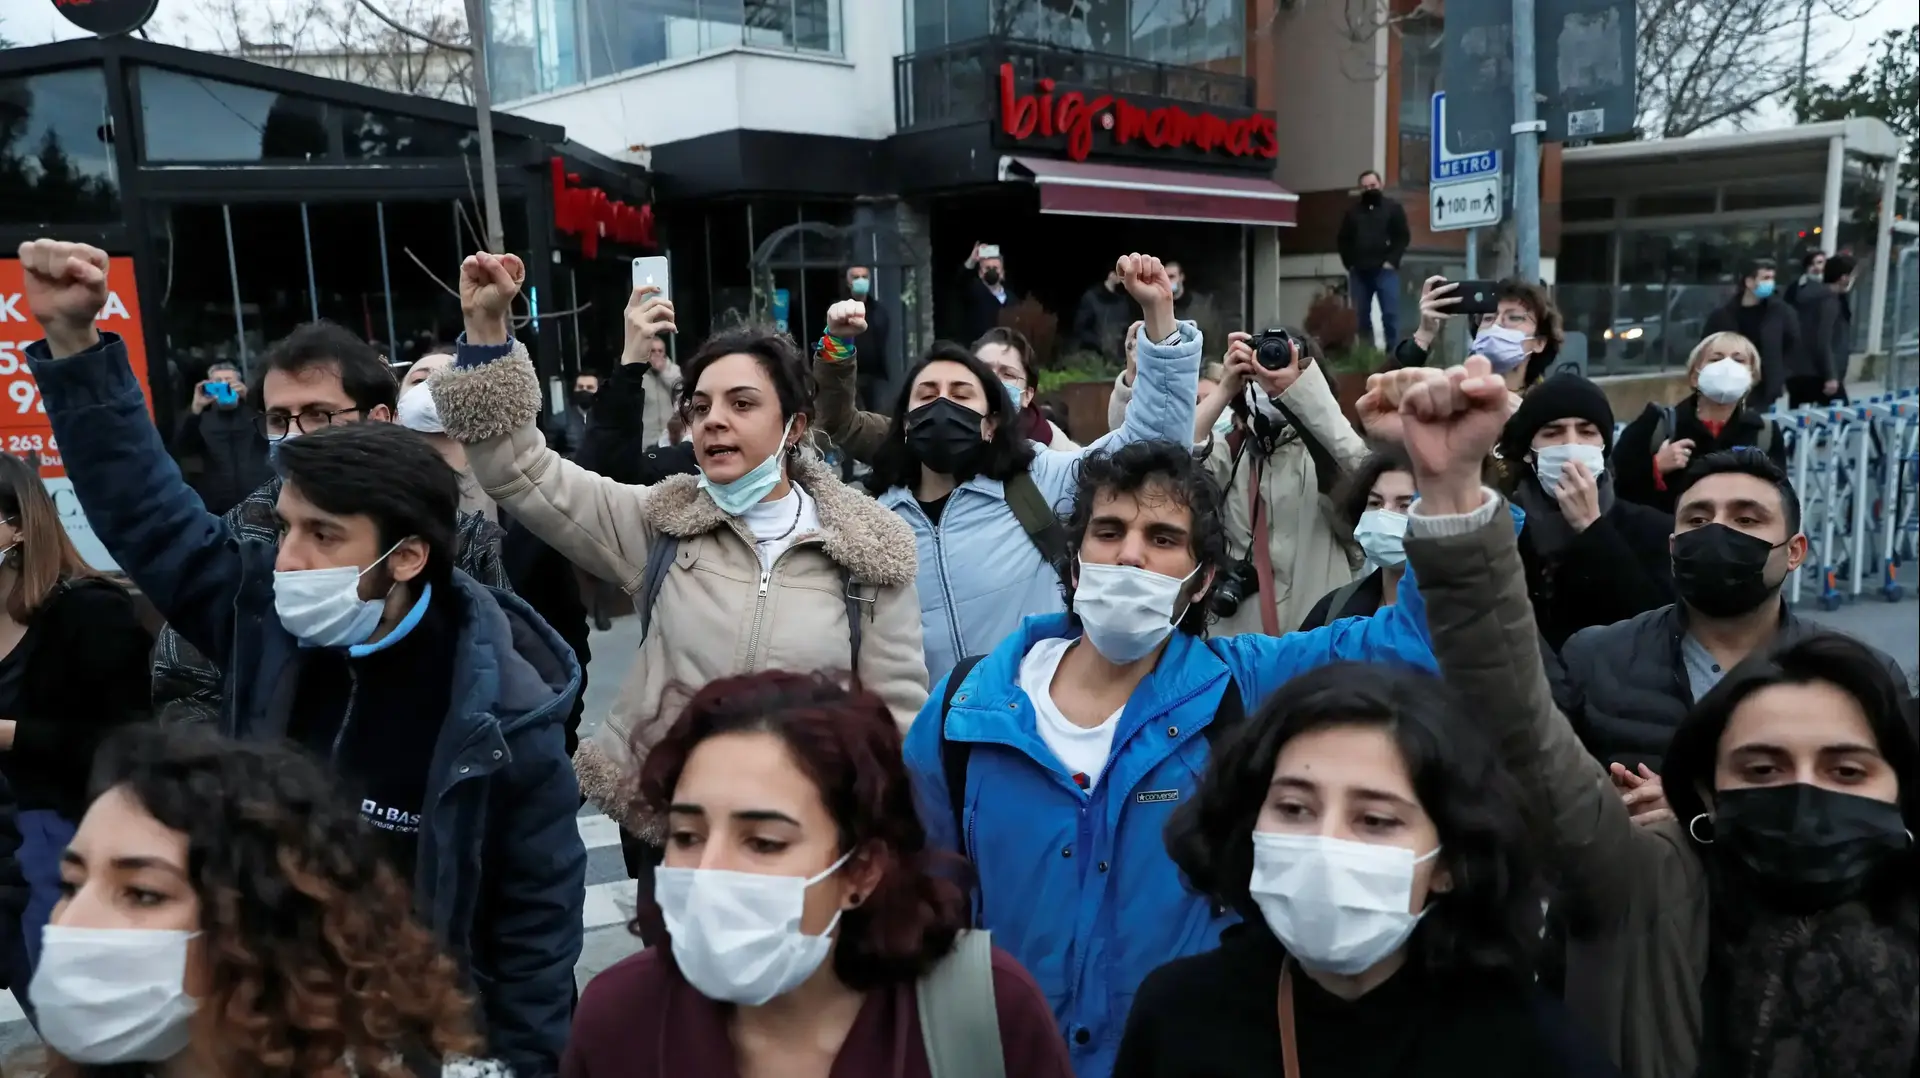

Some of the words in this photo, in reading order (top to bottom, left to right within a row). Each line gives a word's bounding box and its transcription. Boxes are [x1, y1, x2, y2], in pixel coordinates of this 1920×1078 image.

[1000, 62, 1114, 162] big
[1440, 156, 1491, 177] METRO
[1448, 197, 1467, 213] 100
[1470, 198, 1481, 211] m
[95, 291, 131, 320] A
[8, 380, 46, 414] 9
[9, 435, 43, 451] 263
[1145, 792, 1176, 800] converse
